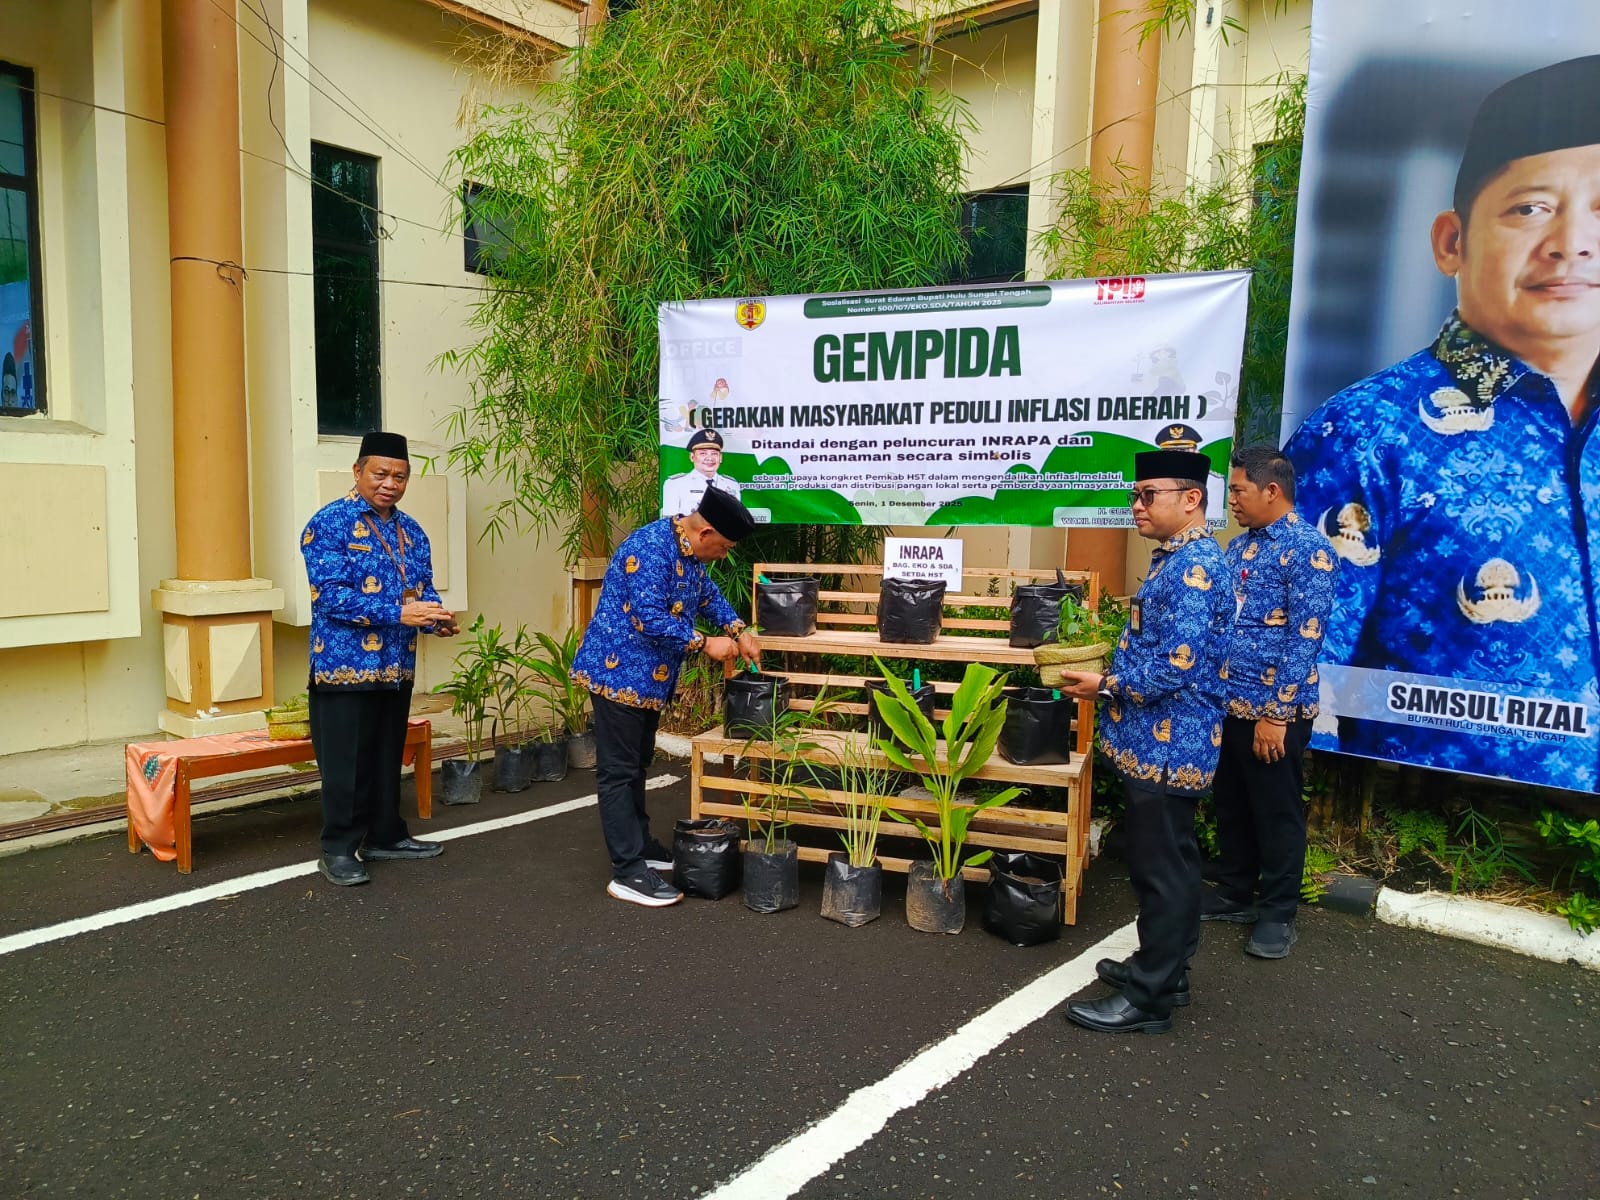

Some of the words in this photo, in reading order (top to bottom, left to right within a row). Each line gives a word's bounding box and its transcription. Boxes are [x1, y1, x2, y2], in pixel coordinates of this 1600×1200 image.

[1095, 277, 1145, 300] TPID
[822, 298, 860, 306] Sosialisasi
[918, 294, 944, 302] Bupati
[968, 290, 998, 298] Sungai
[665, 341, 737, 358] OFFICE
[813, 325, 1022, 383] GEMPIDA
[701, 406, 784, 428] GERAKAN
[790, 402, 924, 427] MASYARAKAT
[930, 400, 1000, 425] PEDULI
[1008, 398, 1090, 422] INFLASI
[1097, 396, 1190, 421] DAERAH
[752, 438, 814, 449] Ditandai
[820, 438, 878, 450] dengan
[883, 436, 976, 450] peluncuran
[982, 435, 1051, 446] INRAPA
[1058, 434, 1091, 446] dan
[800, 453, 892, 464] penanaman
[896, 452, 953, 461] secara
[958, 450, 1031, 461] simbolis
[754, 473, 788, 482] sebagai
[790, 474, 818, 482] upaya
[820, 473, 863, 482] kongkret
[961, 472, 1043, 482] mengendalikan
[1081, 472, 1121, 480] melalui
[740, 482, 786, 490] penguatan
[788, 482, 828, 490] produksi
[991, 482, 1070, 490] pemberdayaan
[900, 545, 944, 560] INRAPA
[1390, 684, 1500, 722] SAMSUL
[1506, 698, 1586, 734] RIZAL
[1408, 714, 1442, 726] BUPATI
[1446, 719, 1473, 730] HULU
[1476, 724, 1517, 736] SUNGAI
[1521, 730, 1566, 743] TENGAH
